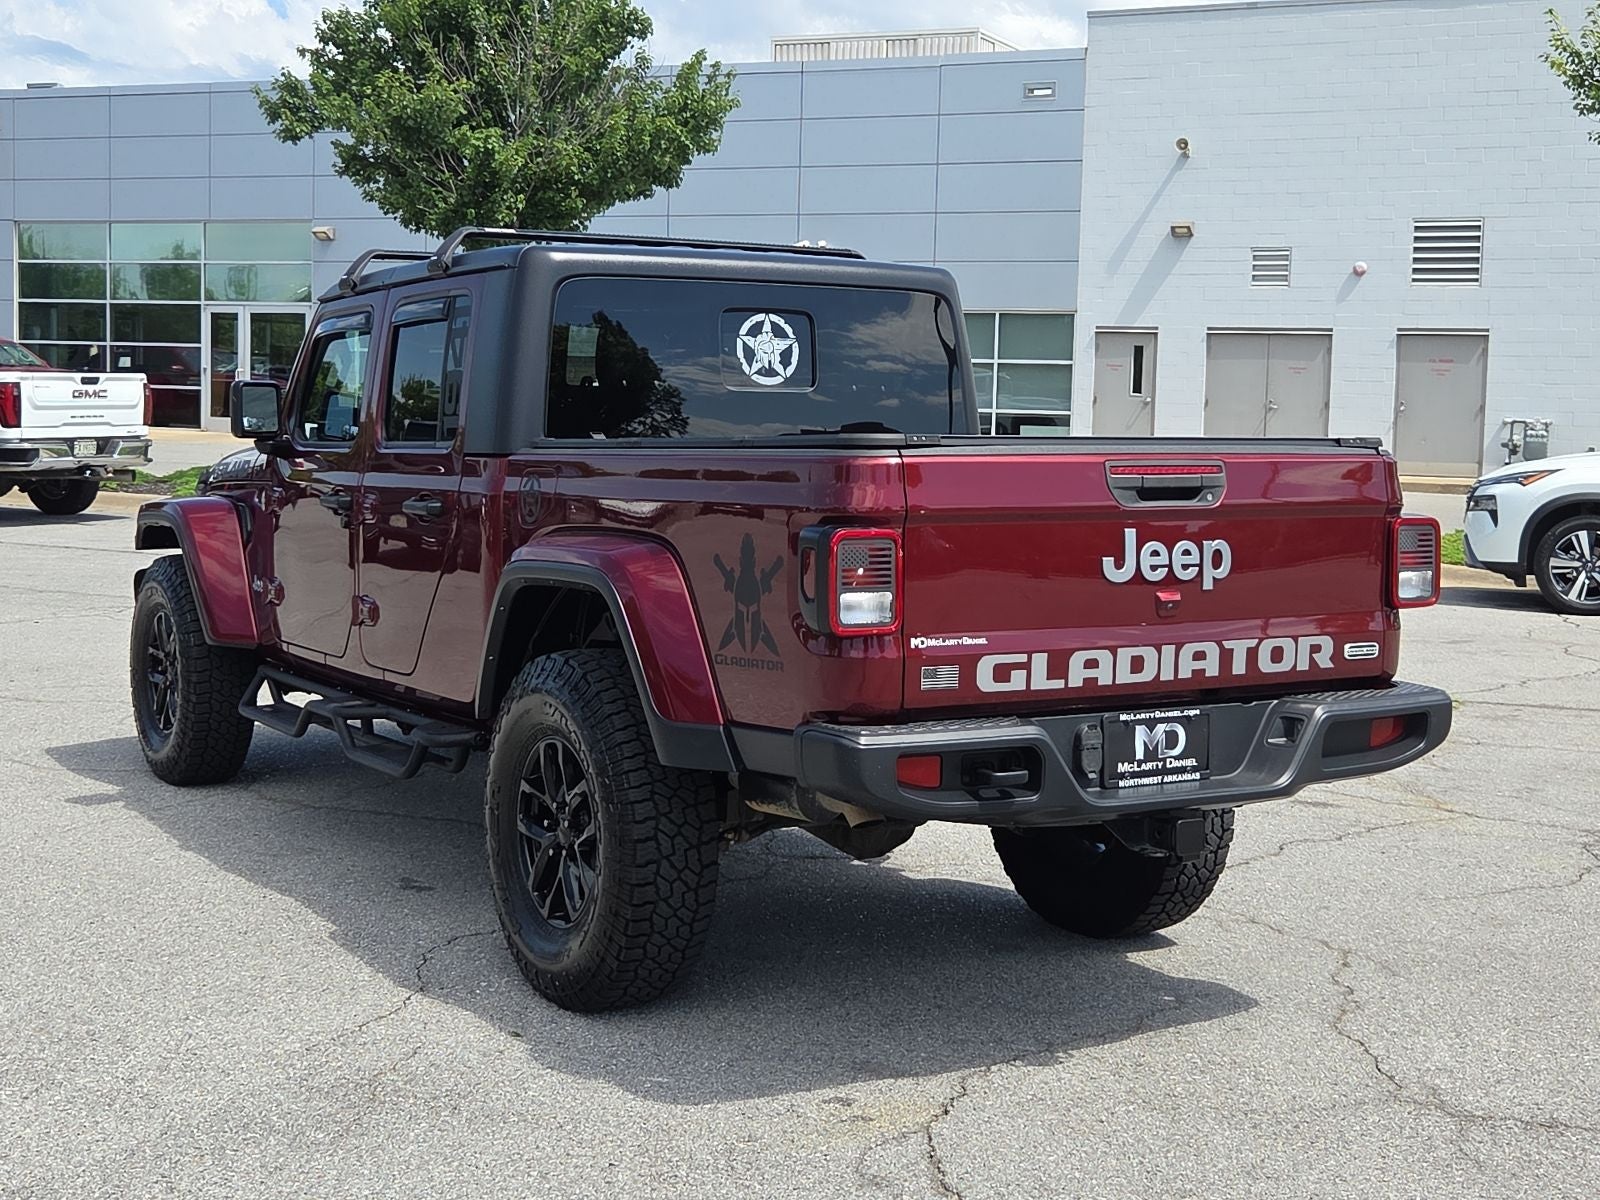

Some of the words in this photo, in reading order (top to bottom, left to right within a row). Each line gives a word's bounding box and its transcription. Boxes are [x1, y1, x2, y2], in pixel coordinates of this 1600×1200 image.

[72, 389, 108, 399] GMC
[1102, 527, 1232, 590] Jeep
[910, 637, 928, 649] MD
[714, 653, 785, 672] GLADIATOR
[976, 635, 1335, 692] GLADIATOR
[1135, 722, 1186, 760] MD
[1118, 775, 1162, 788] NORTHWEST
[1163, 771, 1200, 783] ARKANSAS
